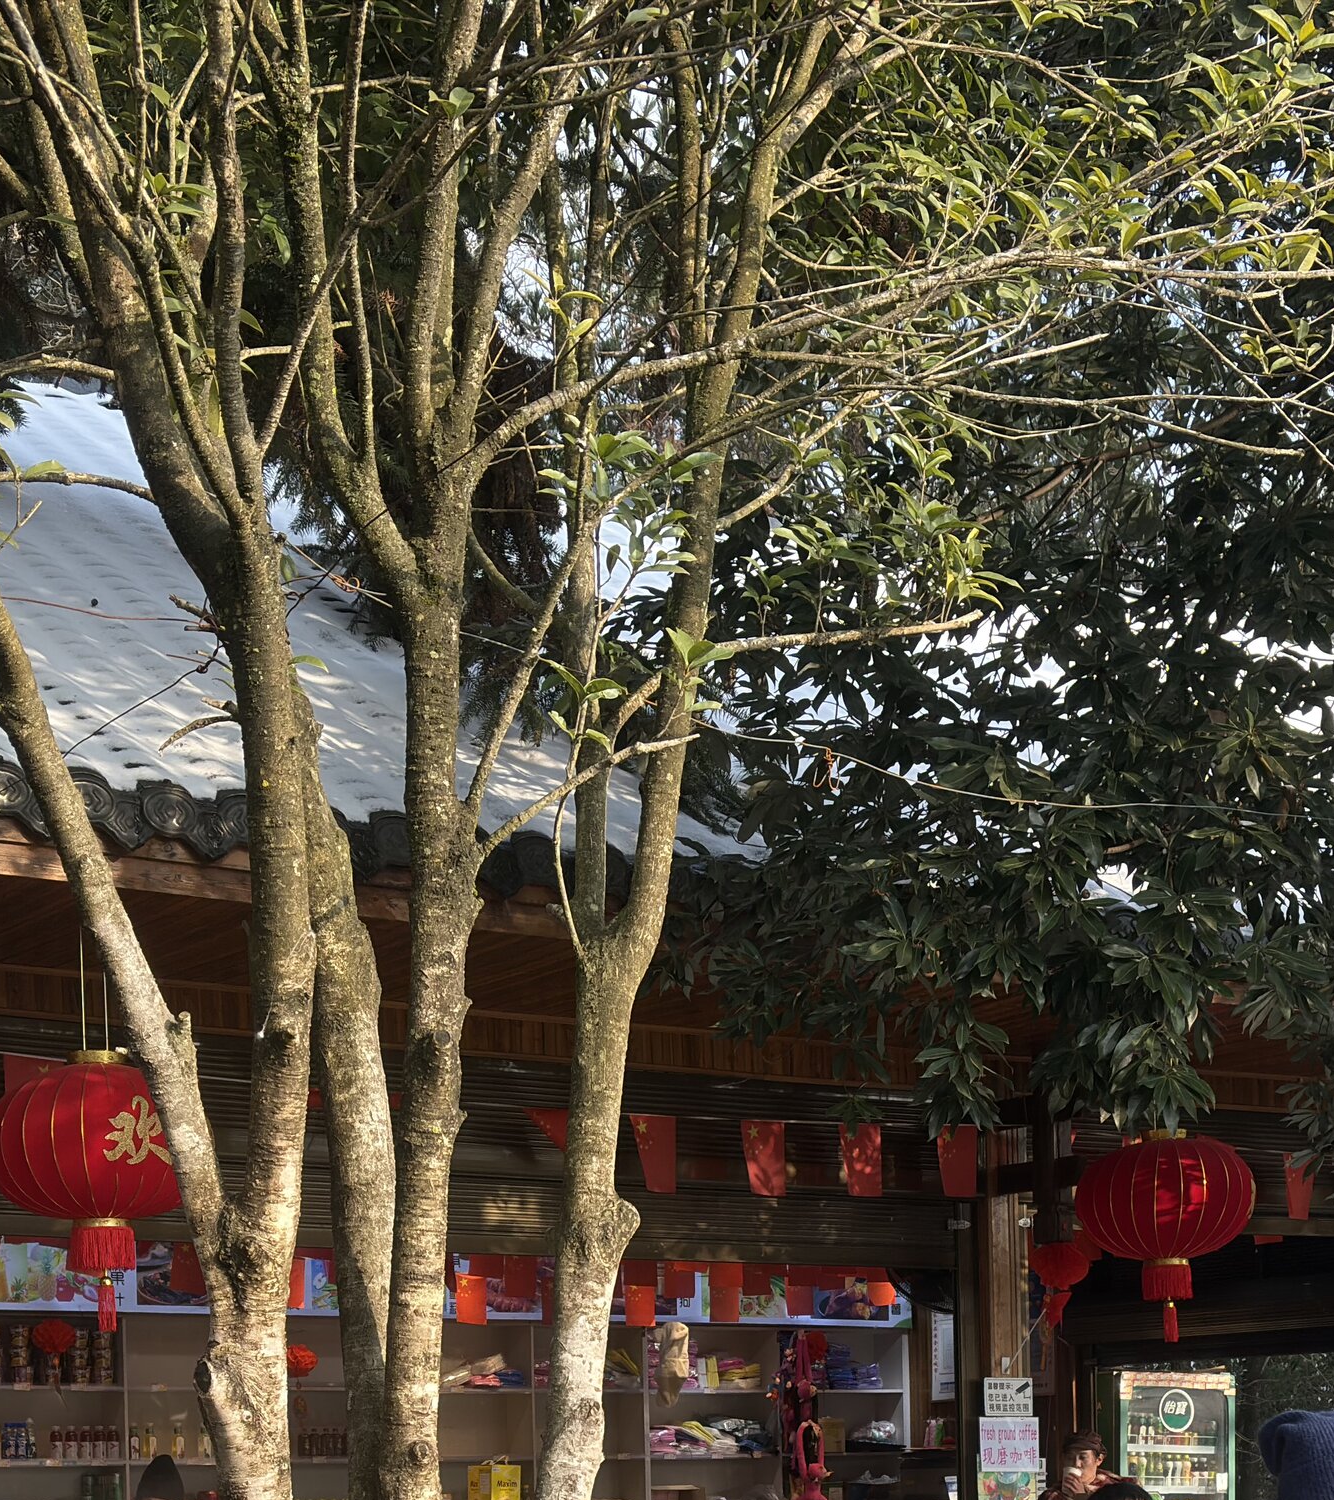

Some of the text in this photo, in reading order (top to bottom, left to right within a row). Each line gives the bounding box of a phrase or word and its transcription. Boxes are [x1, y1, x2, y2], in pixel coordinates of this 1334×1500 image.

[103, 1095, 173, 1166] 欢
[988, 1393, 1015, 1402] 您已进入
[988, 1403, 1030, 1413] 视频监控范围
[998, 1424, 1016, 1444] ground
[1018, 1424, 1038, 1441] coffee
[982, 1446, 1038, 1466] 现磨咖啡
[496, 1479, 518, 1489] Maxim
